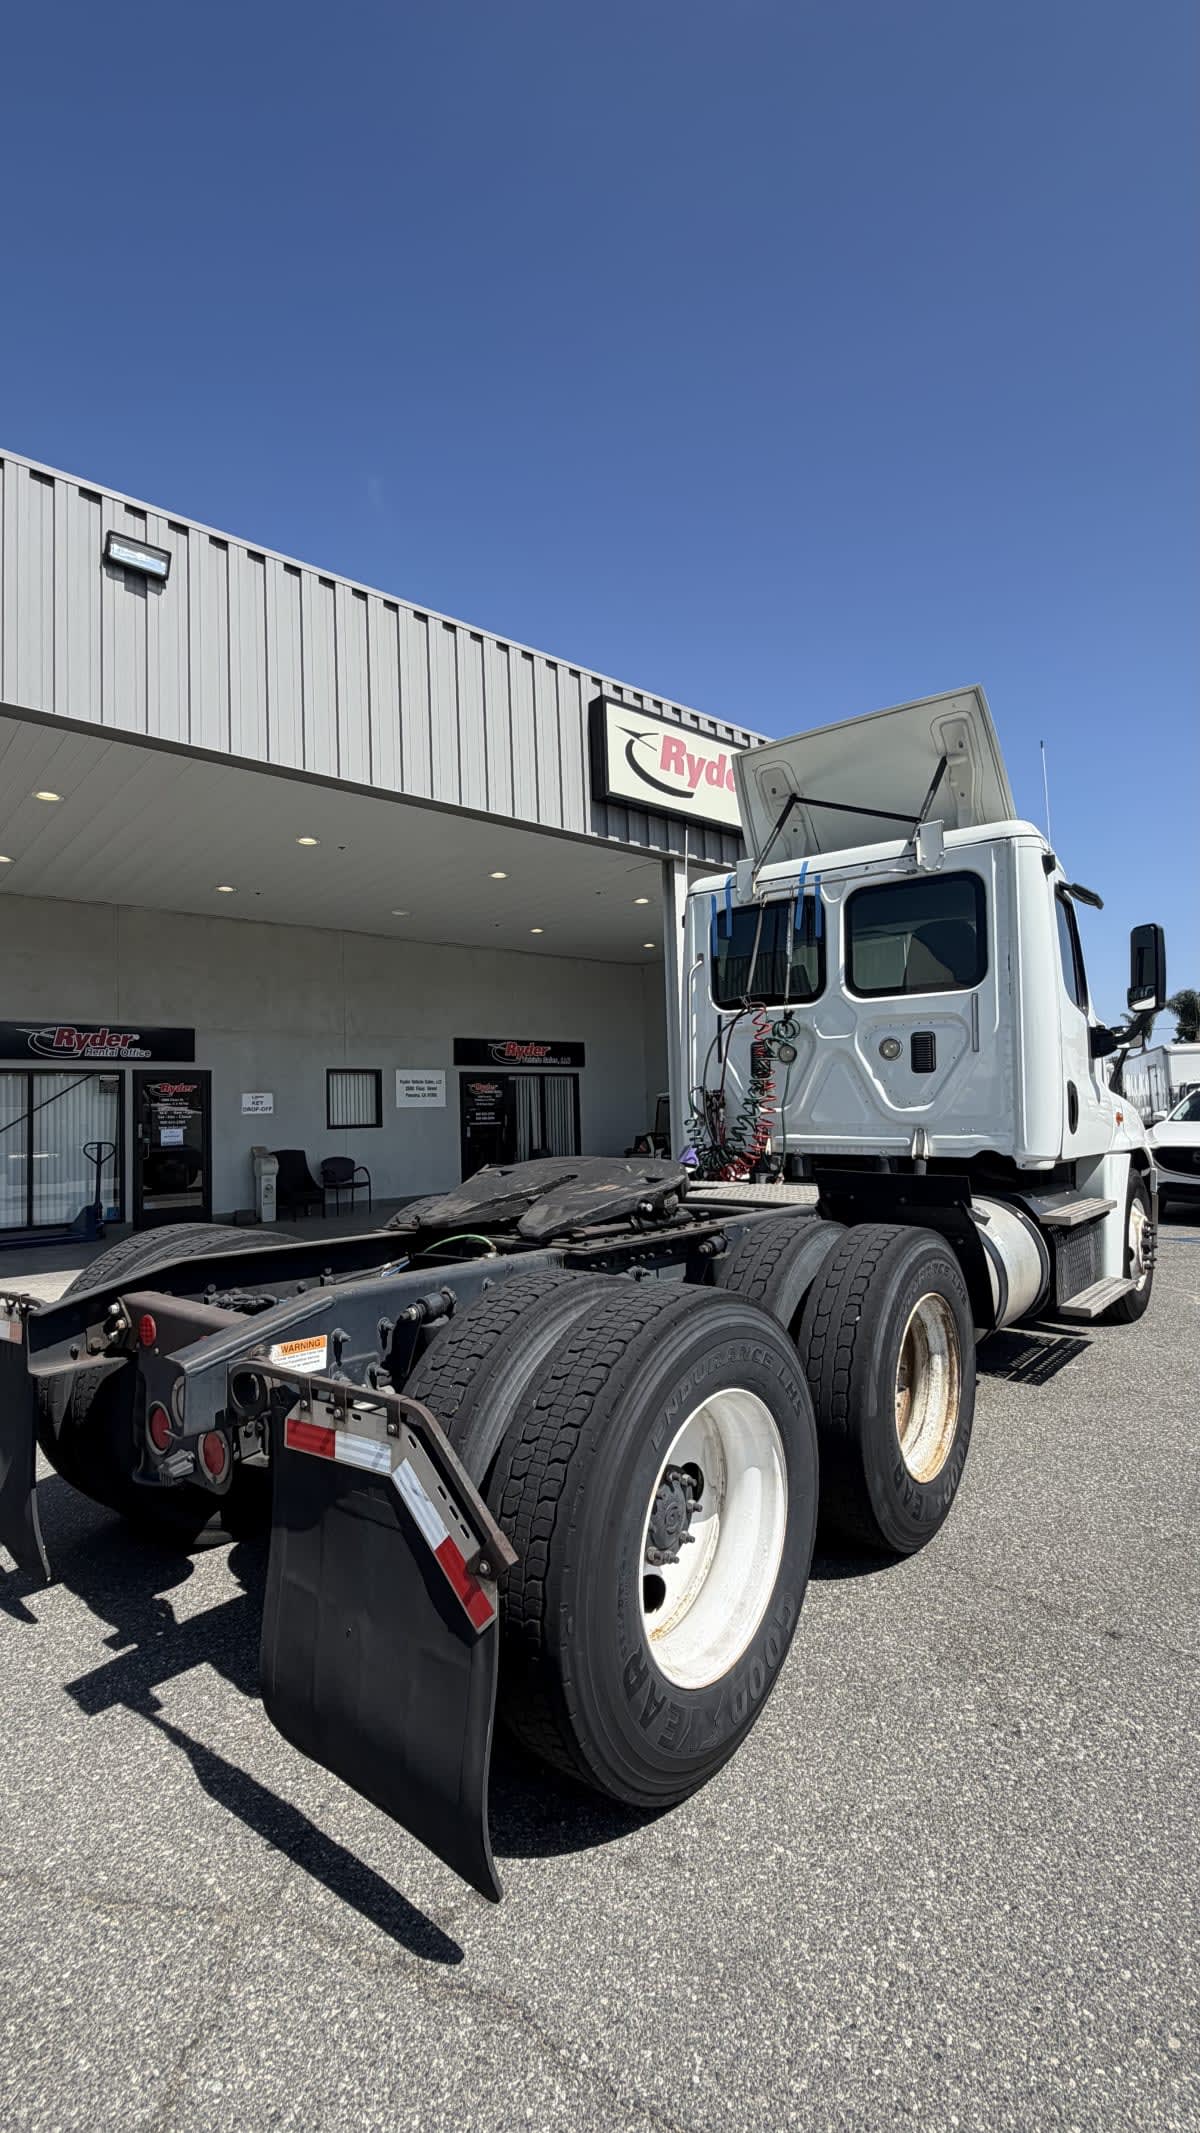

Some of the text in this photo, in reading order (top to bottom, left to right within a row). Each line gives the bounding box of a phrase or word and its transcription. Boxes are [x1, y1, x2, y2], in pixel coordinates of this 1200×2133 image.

[53, 1027, 135, 1053] Ryder
[84, 1047, 151, 1058] Rental Office
[505, 1041, 549, 1061] Ryder
[160, 1083, 193, 1096] Ryder
[281, 1339, 321, 1353] WARNING
[650, 1344, 773, 1452] ENDURANCE
[623, 1594, 797, 1753] GOODYEAR
